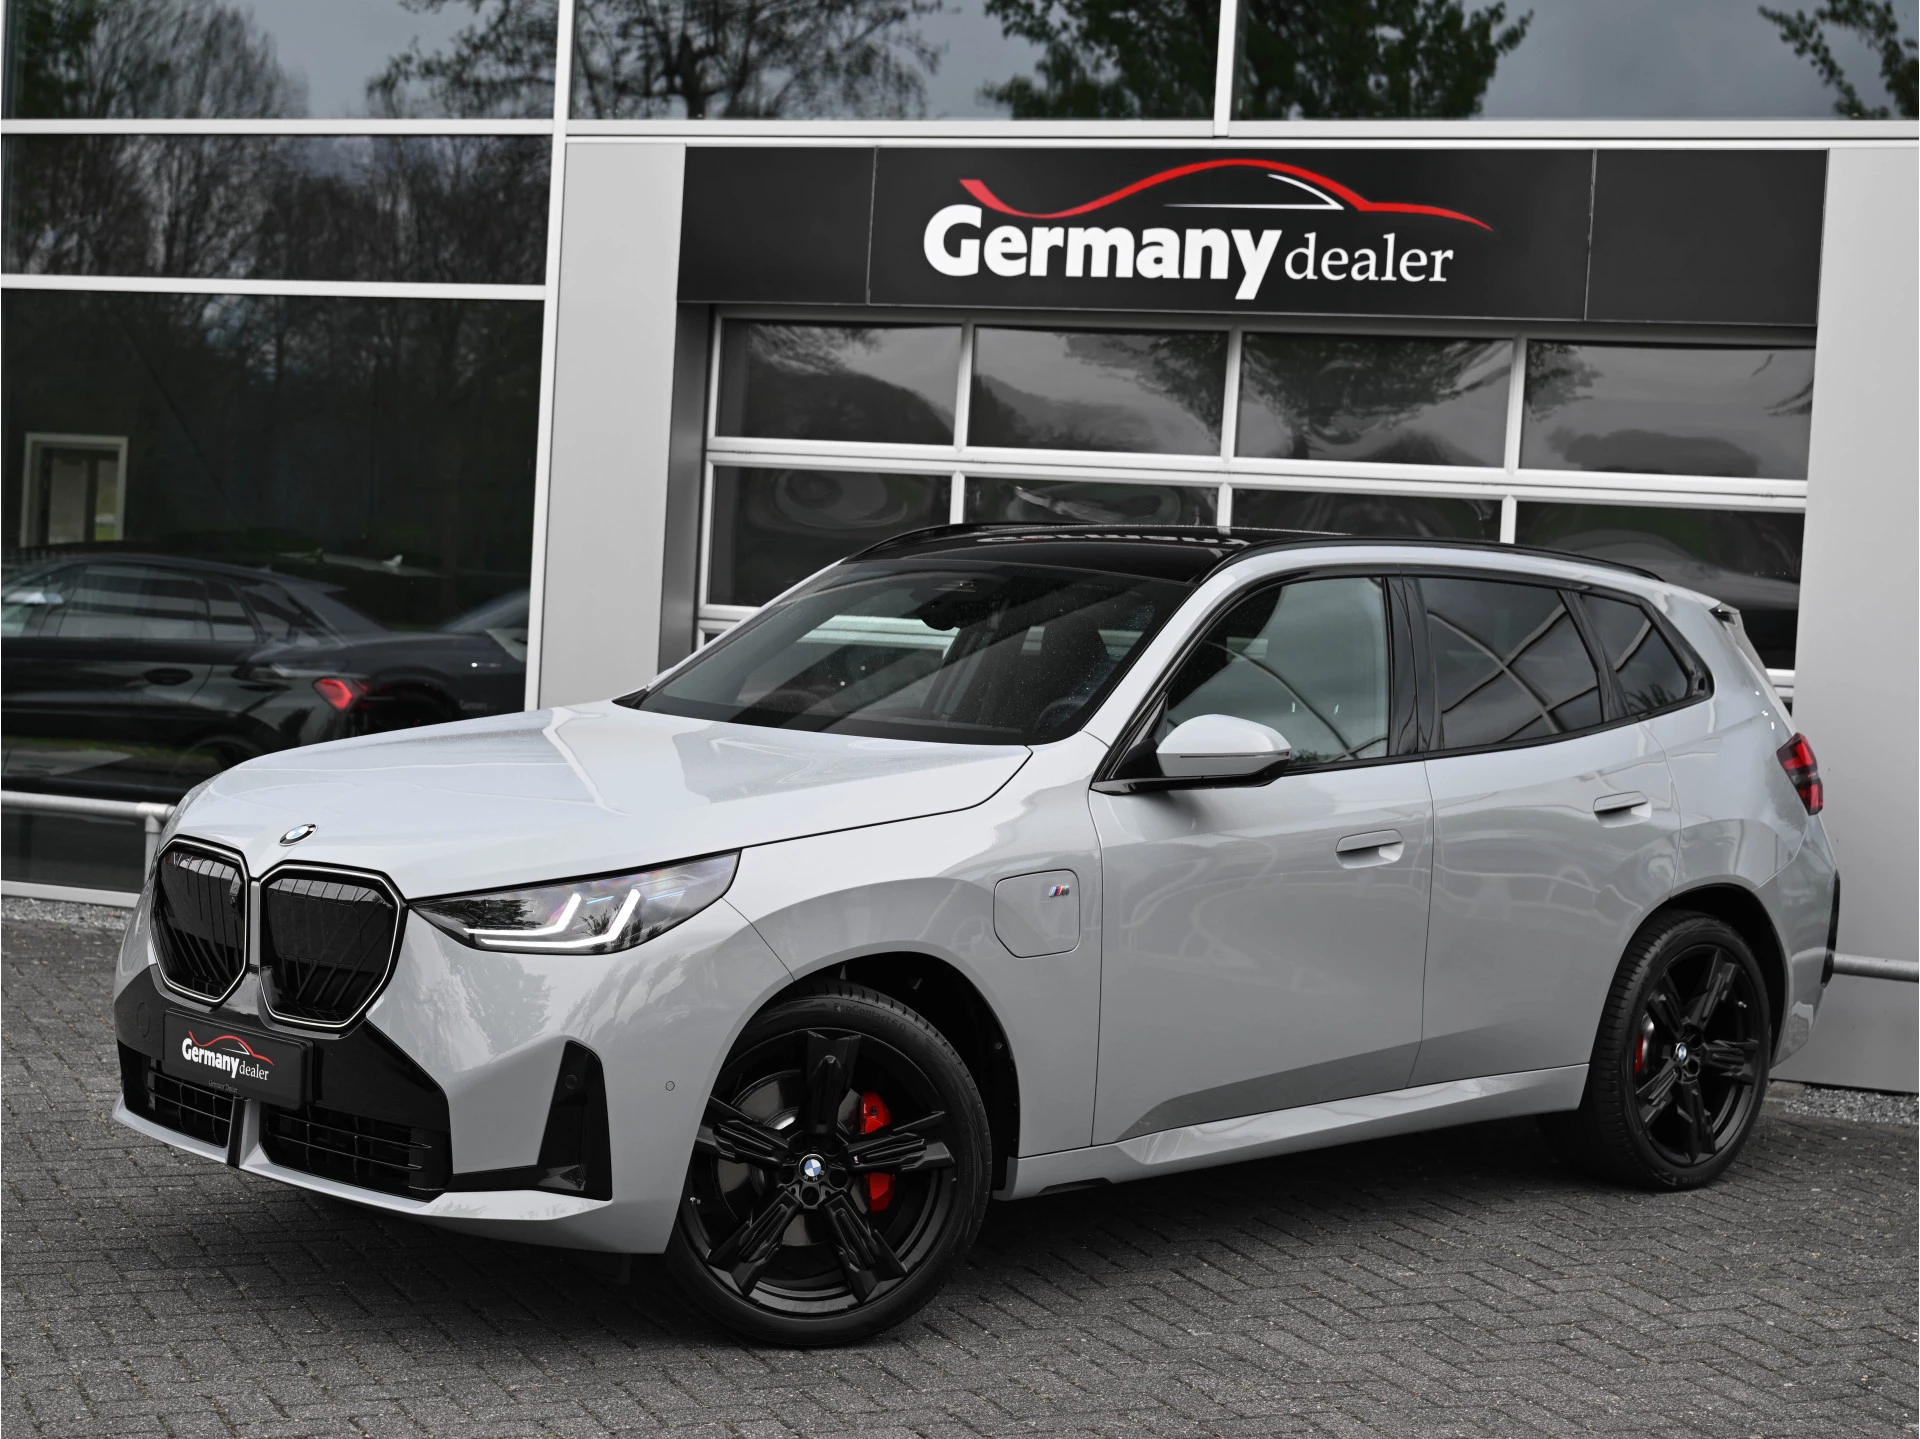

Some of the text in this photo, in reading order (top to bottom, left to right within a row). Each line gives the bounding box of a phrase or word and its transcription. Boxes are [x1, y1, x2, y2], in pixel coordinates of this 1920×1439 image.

[923, 204, 1453, 300] Germany dealer
[181, 1038, 270, 1081] Germany dealer
